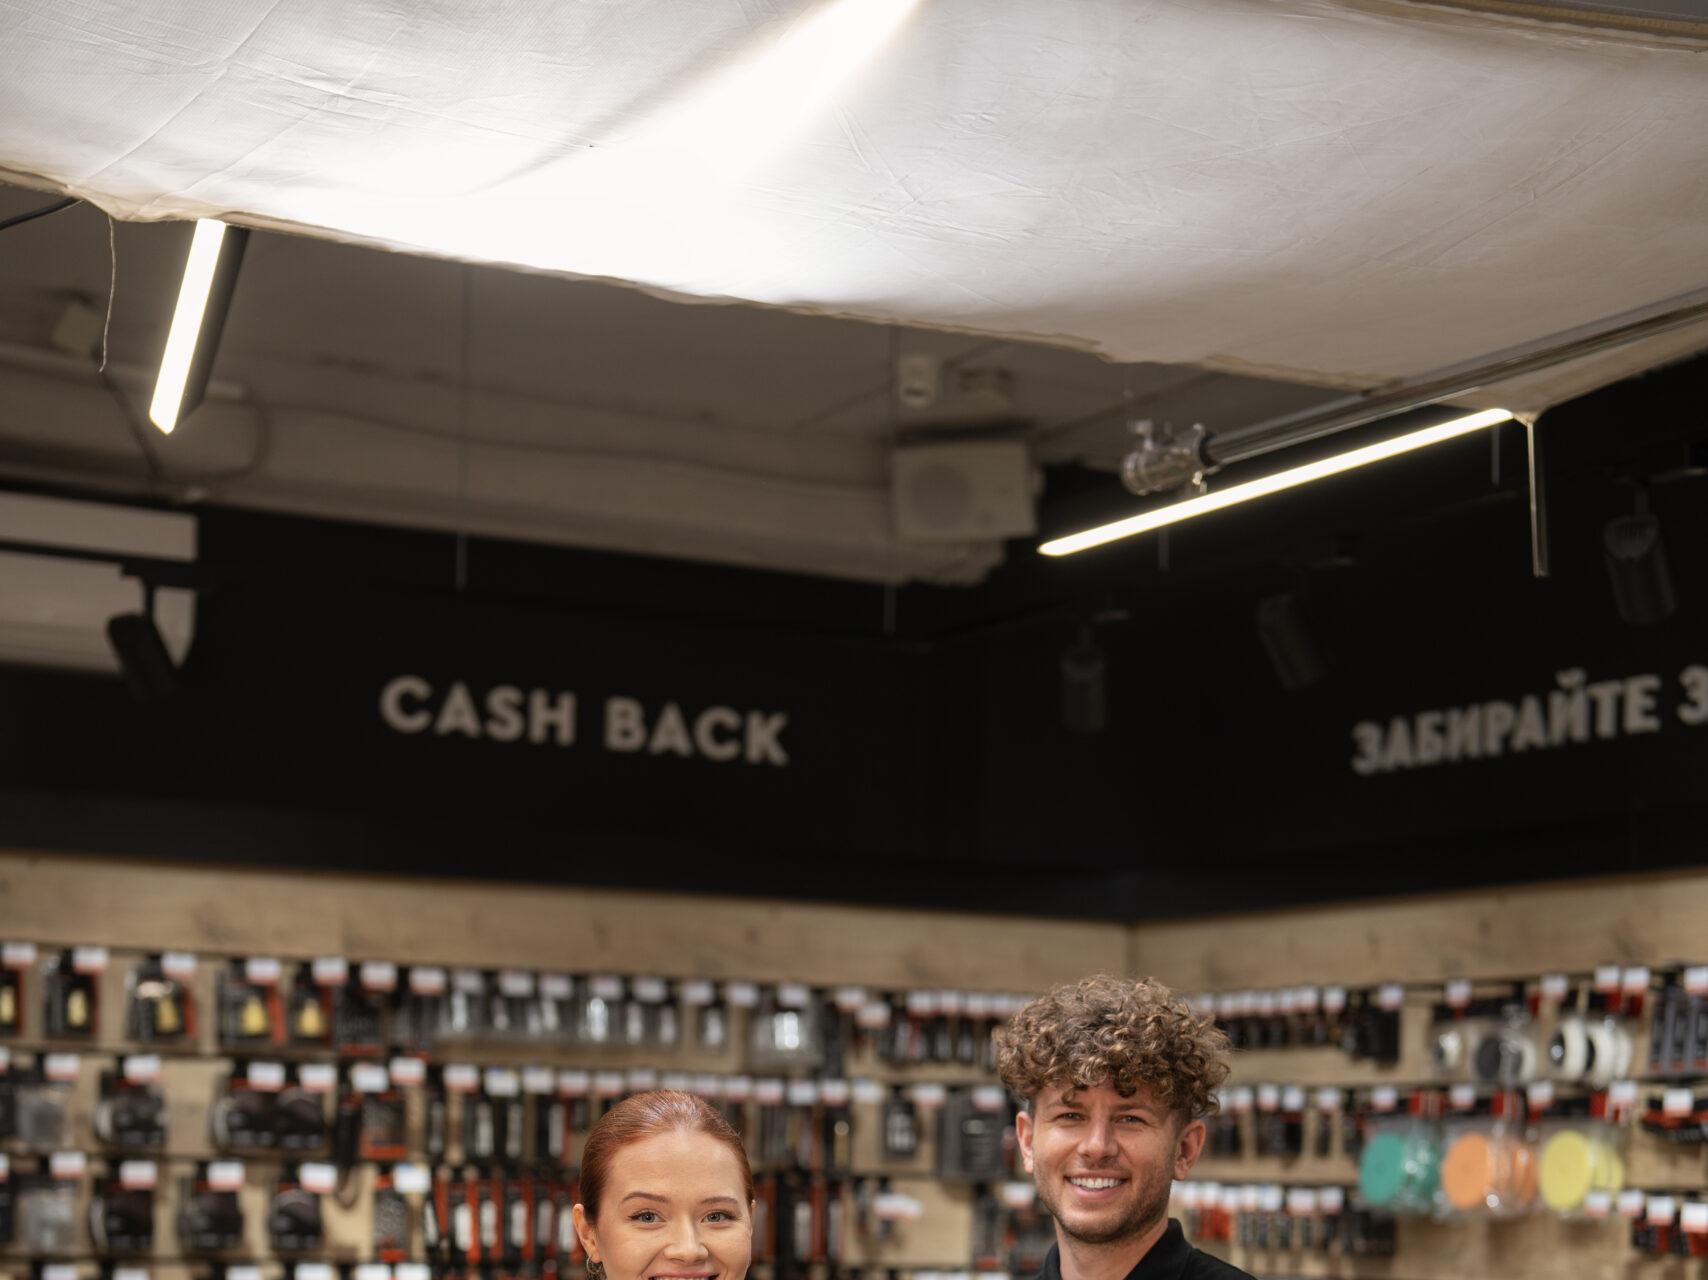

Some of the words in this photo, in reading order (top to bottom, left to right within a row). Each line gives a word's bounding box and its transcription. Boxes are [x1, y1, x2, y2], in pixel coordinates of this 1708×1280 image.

[381, 676, 576, 745] CASH
[605, 697, 786, 765] BACK
[1354, 669, 1660, 773] ЗАБИРАЙТЕ
